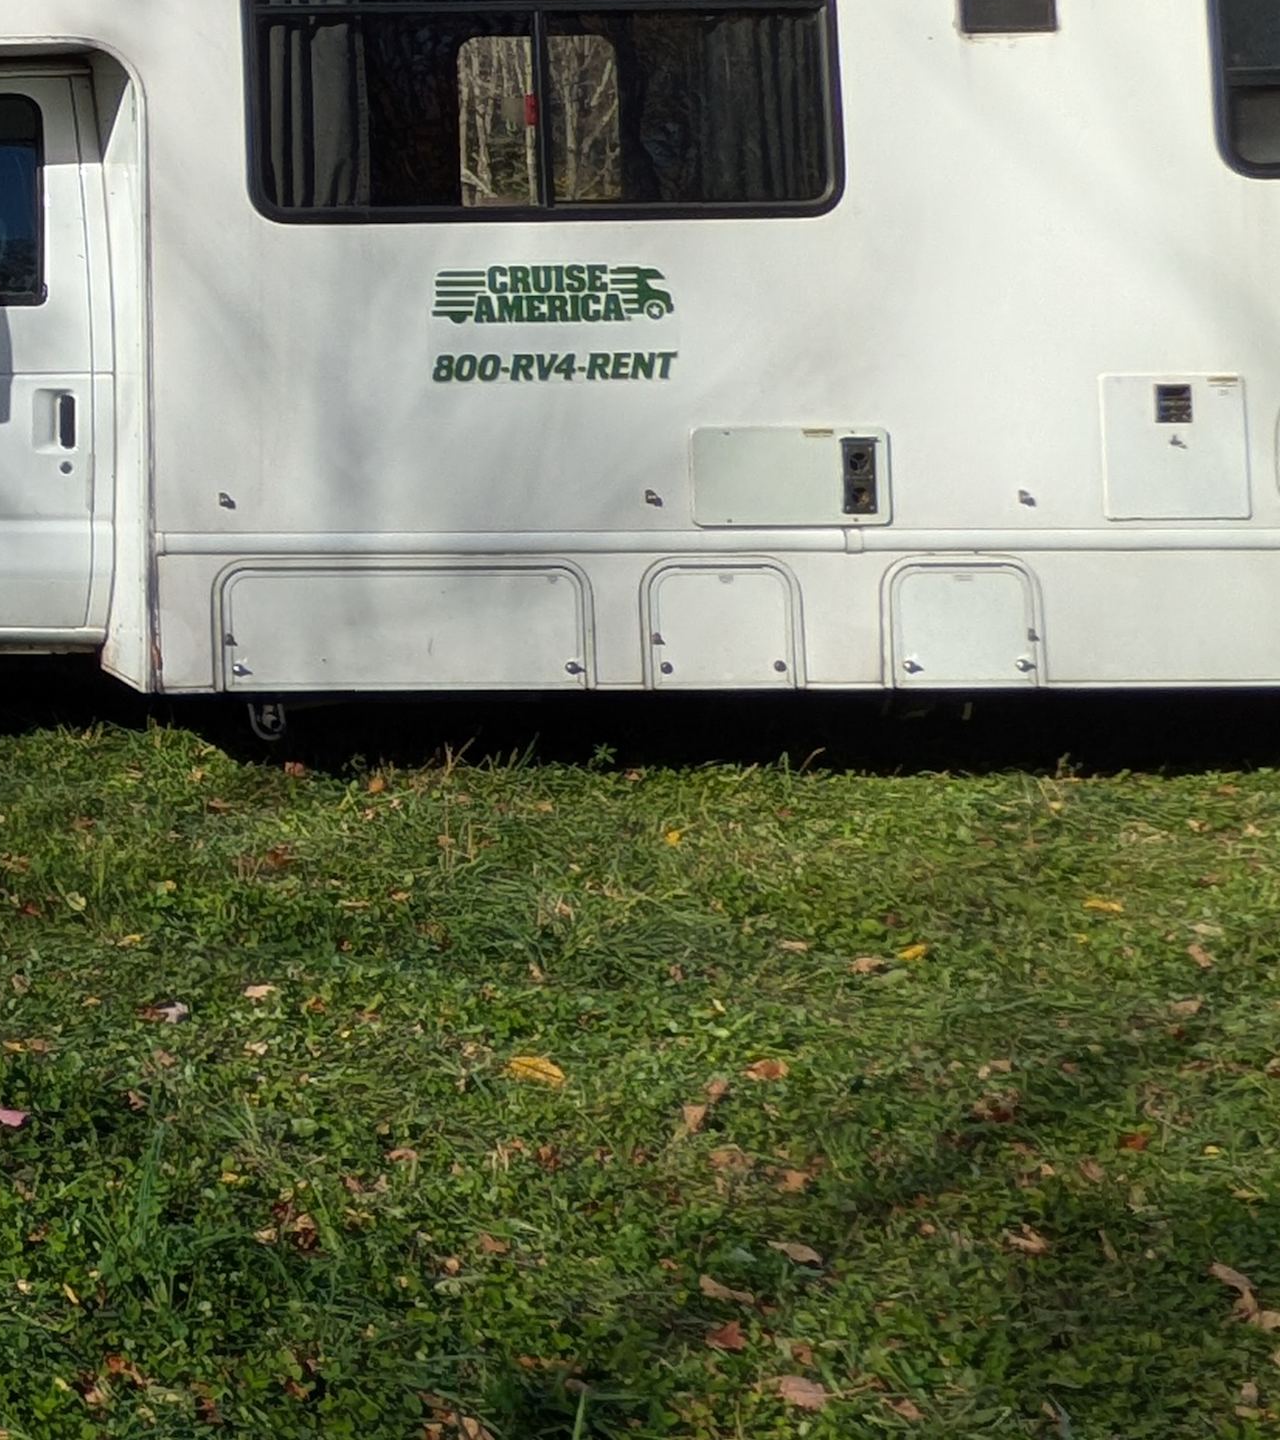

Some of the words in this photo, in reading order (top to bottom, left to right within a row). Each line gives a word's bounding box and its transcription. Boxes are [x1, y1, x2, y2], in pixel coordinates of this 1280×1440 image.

[487, 264, 608, 294] CRUISE
[474, 293, 627, 323] AMERICA
[432, 352, 678, 382] 800-RV4-RENT
